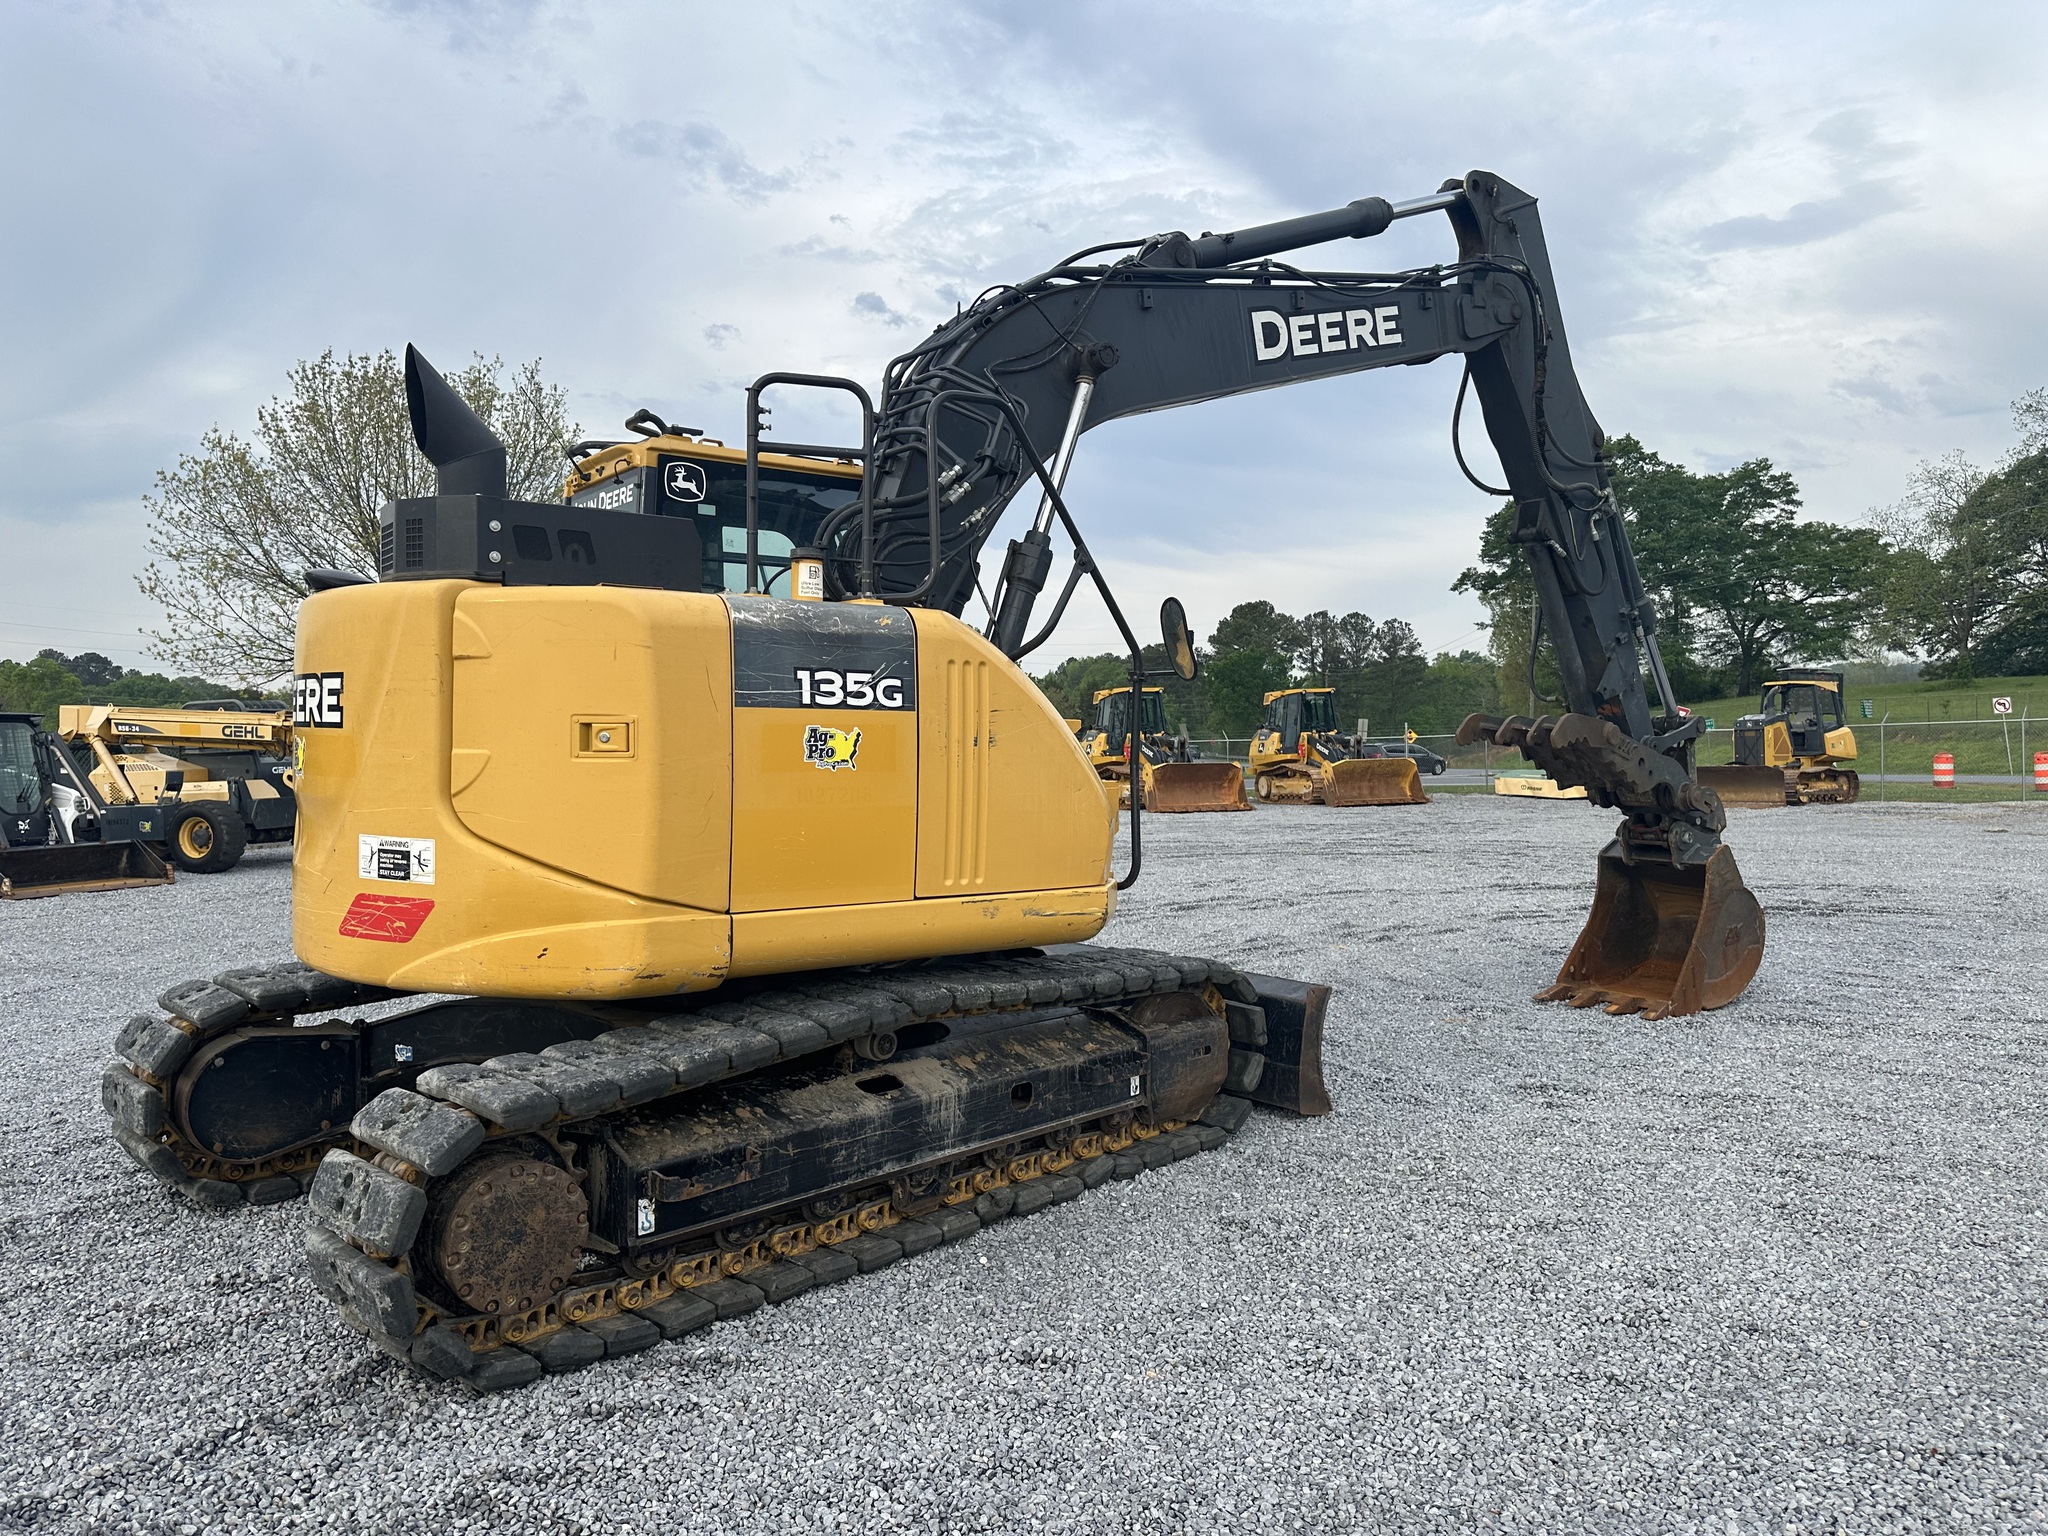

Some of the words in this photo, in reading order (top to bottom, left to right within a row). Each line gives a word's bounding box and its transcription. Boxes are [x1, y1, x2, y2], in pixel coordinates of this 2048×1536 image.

[1251, 305, 1402, 361] DEERE
[598, 483, 634, 509] DEERE
[293, 677, 342, 723] ERE
[796, 670, 903, 708] 135G
[221, 725, 265, 740] GEHL
[808, 743, 835, 759] Pro
[384, 840, 409, 848] WARNING
